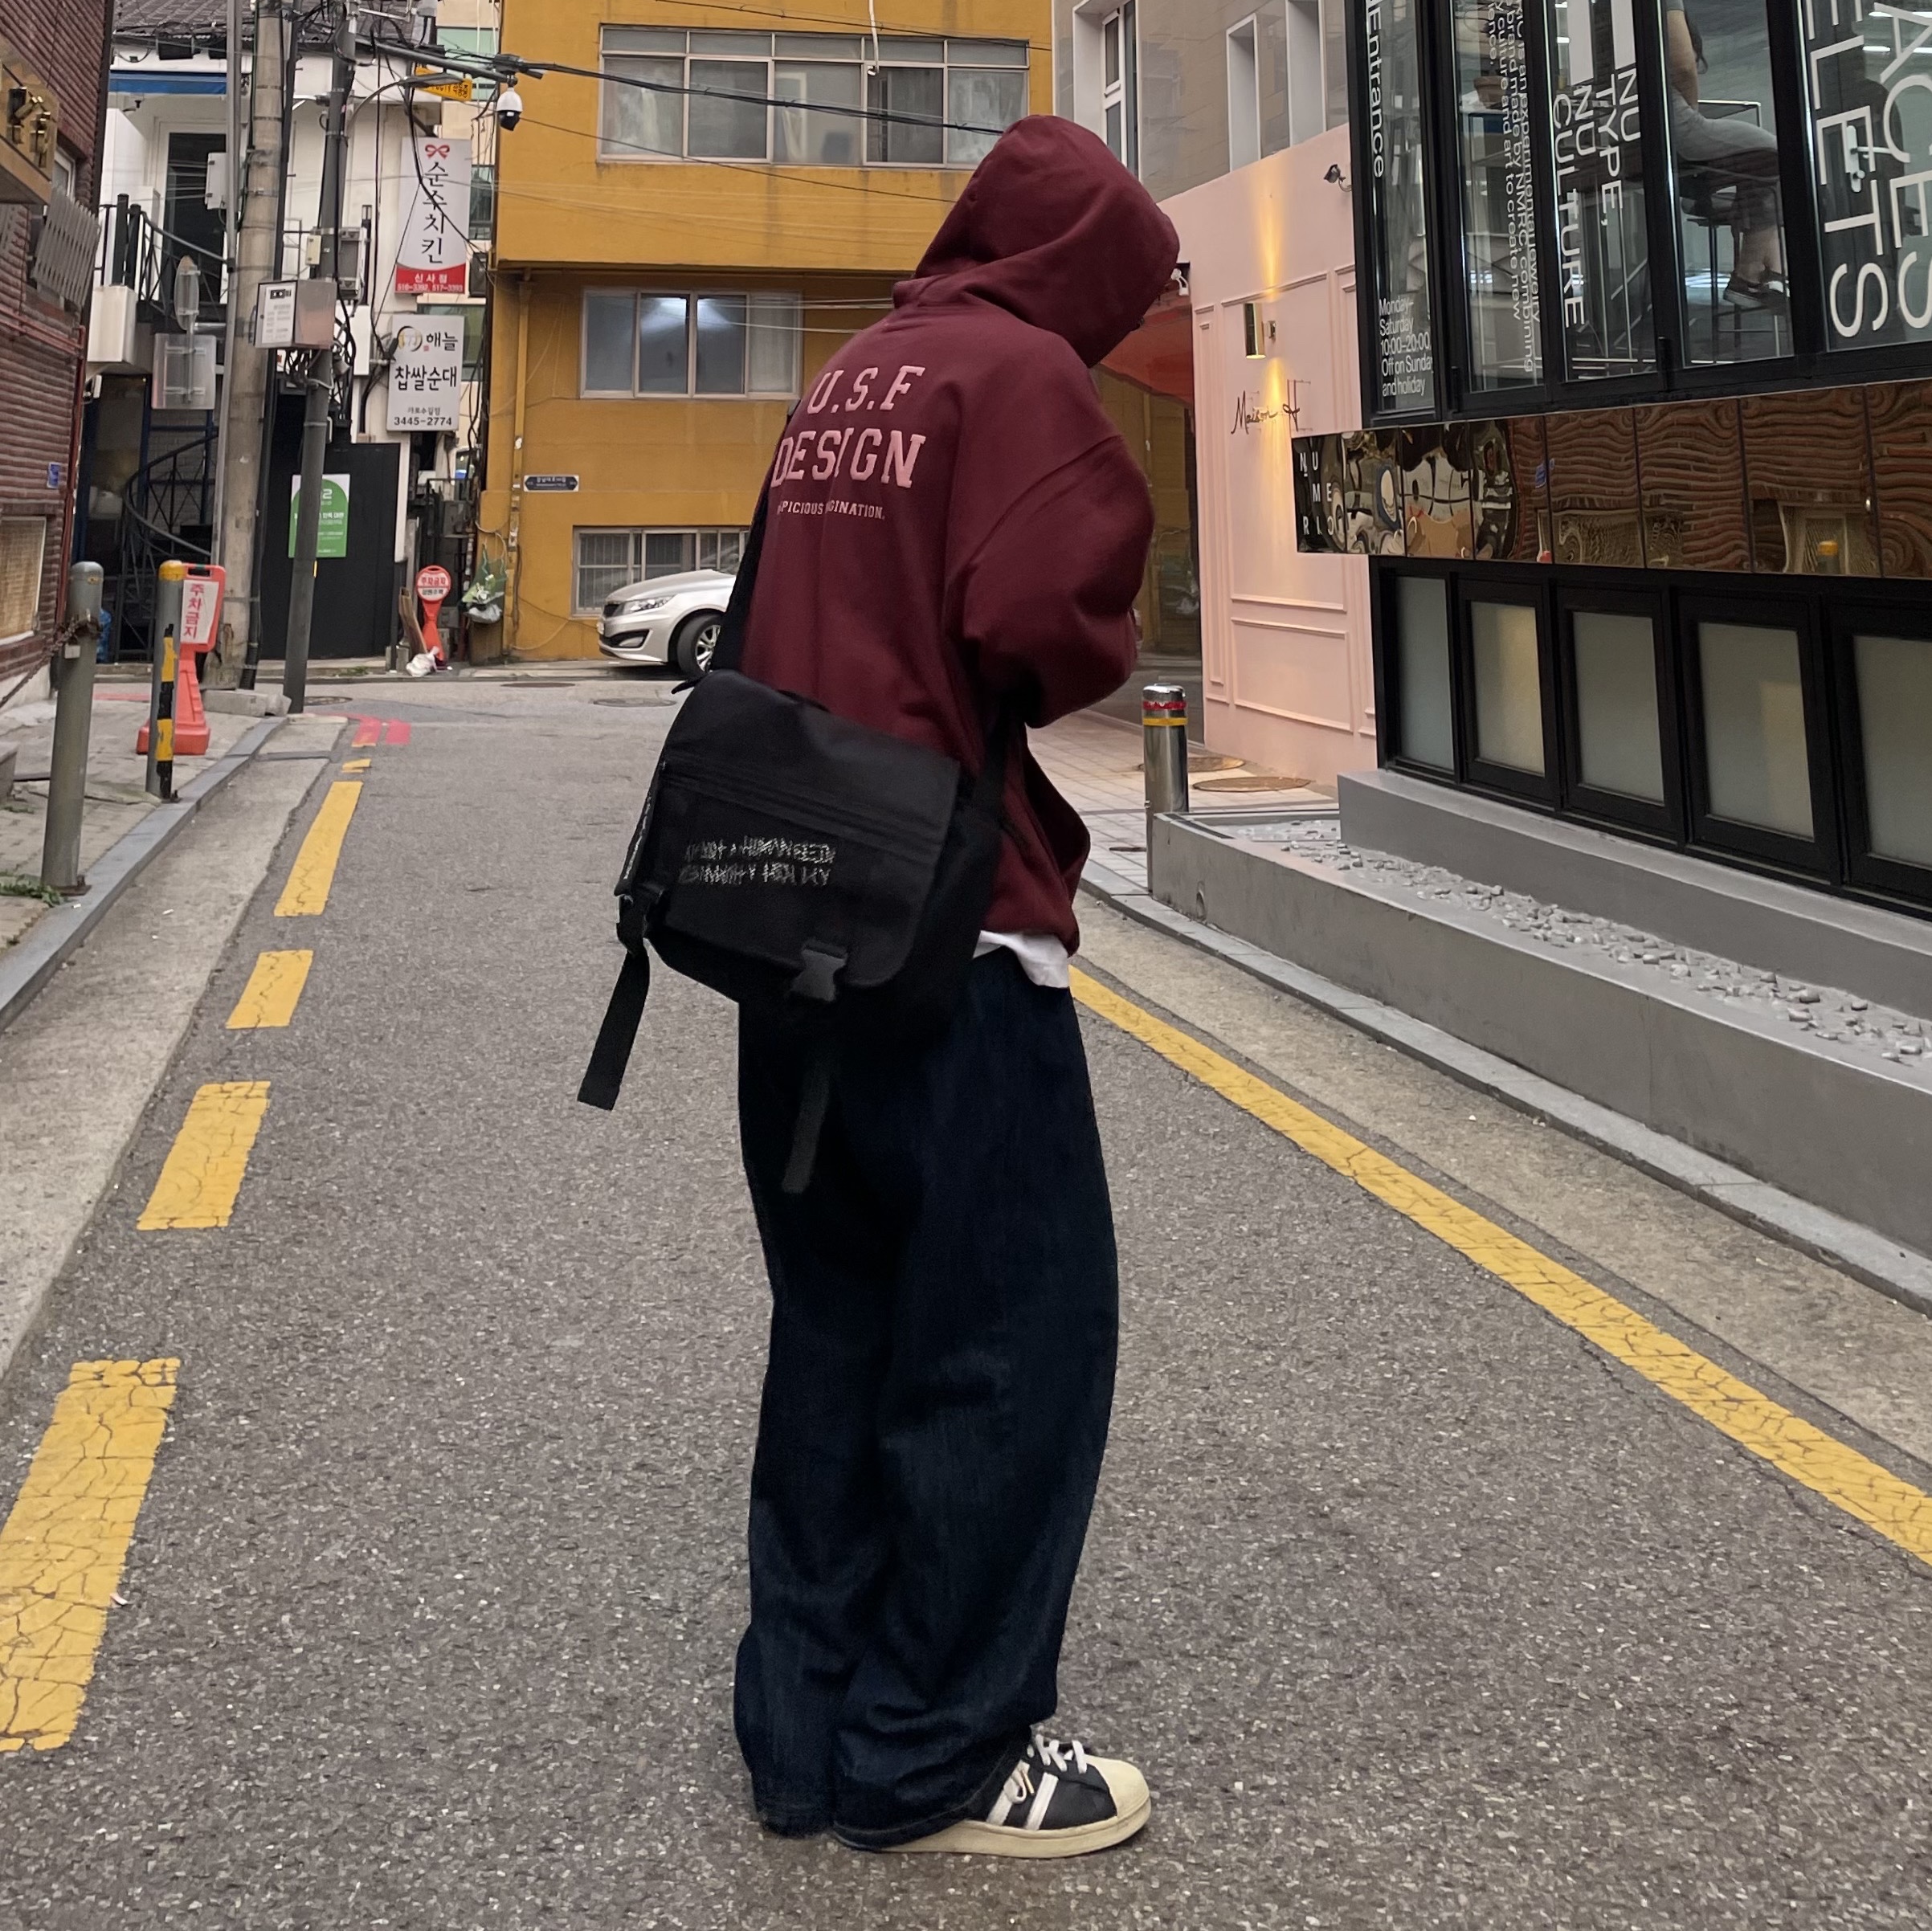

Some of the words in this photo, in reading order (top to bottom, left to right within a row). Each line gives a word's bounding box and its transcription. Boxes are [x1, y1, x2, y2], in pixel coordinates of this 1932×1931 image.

[1497, 17, 1509, 92] culture
[1507, 10, 1518, 72] brand
[1517, 42, 1526, 60] is
[1368, 6, 1385, 178] Entrance
[1519, 65, 1527, 90] an
[1618, 68, 1641, 142] NU
[1501, 96, 1513, 135] and
[1510, 76, 1522, 137] made
[1573, 84, 1597, 157] NU
[1504, 140, 1514, 169] art
[1513, 141, 1523, 168] by
[1520, 92, 1536, 238] experimental
[1595, 73, 1624, 227] TYPE,
[421, 161, 449, 263] 순수치킨
[1505, 173, 1514, 195] to
[1553, 93, 1586, 329] CULTURE
[1507, 199, 1518, 269] create
[1515, 173, 1528, 252] NMRC,
[1511, 274, 1522, 320] new
[1528, 241, 1541, 321] jewelry
[426, 331, 458, 351] 해늘
[1379, 317, 1414, 337] Saturday
[1520, 255, 1534, 372] combining
[394, 364, 457, 391] 찹쌀순대
[807, 365, 925, 414] U.S.F
[1382, 357, 1394, 377] Off
[1395, 360, 1405, 375] on
[1383, 377, 1396, 397] and
[1396, 374, 1425, 396] holiday
[394, 416, 452, 426] 3445-2774
[1231, 390, 1278, 435] Maison
[770, 427, 926, 488] DESIGN
[184, 583, 204, 639] 주차금지
